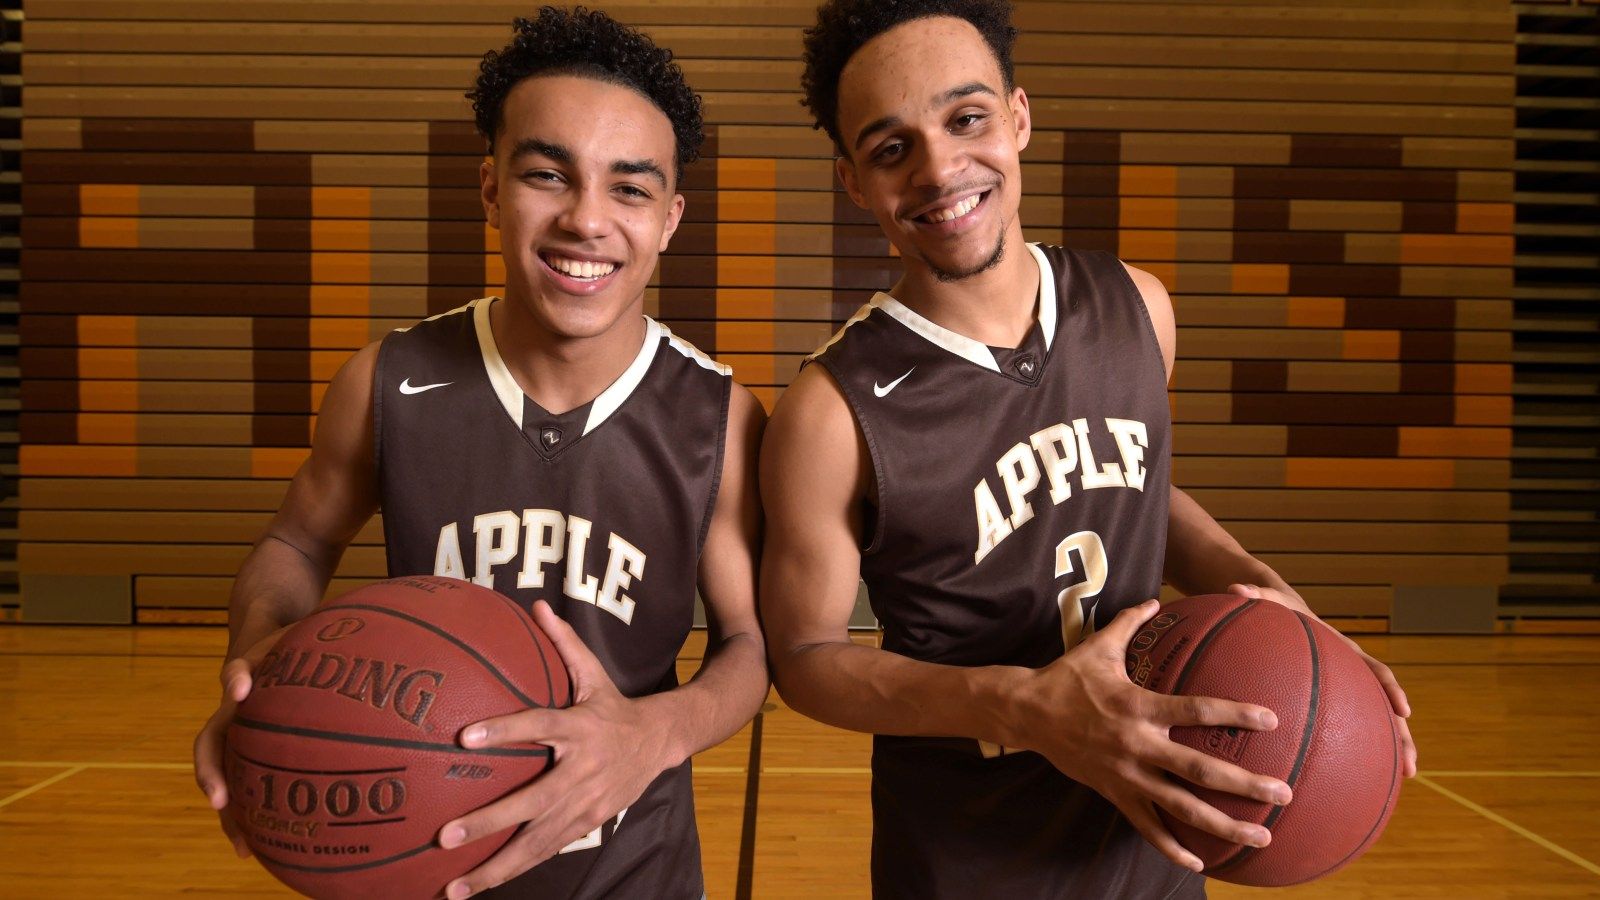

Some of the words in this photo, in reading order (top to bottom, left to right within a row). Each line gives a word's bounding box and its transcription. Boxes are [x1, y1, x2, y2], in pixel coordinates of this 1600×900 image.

[974, 418, 1149, 565] APPLE
[434, 508, 647, 626] APPLE
[256, 649, 444, 729] PALDING
[313, 845, 371, 855] DESIGN
